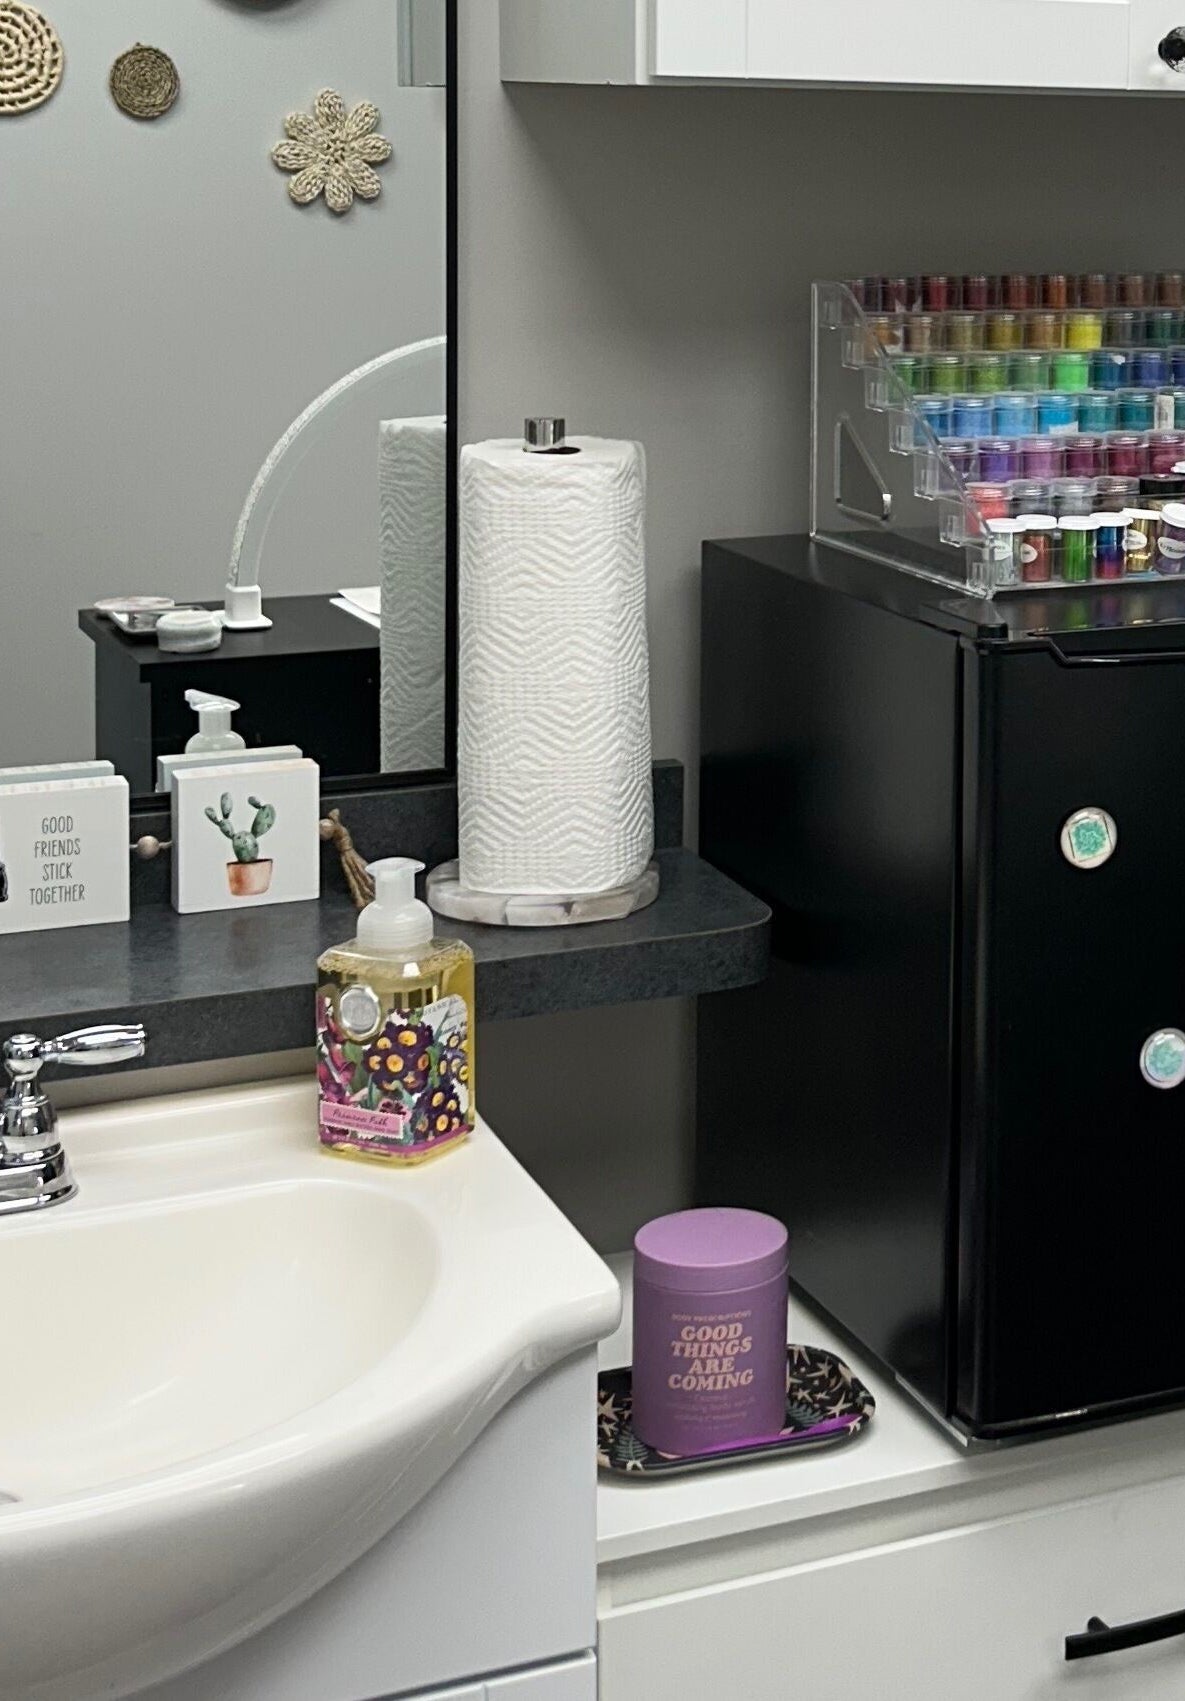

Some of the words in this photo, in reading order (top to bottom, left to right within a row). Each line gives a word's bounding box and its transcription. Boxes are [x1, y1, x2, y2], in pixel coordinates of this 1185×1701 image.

[41, 815, 73, 834] GOOD
[34, 838, 81, 858] FRIENDS
[42, 861, 73, 882] STICK
[29, 883, 86, 906] TOGETHER
[680, 1322, 743, 1341] GOOD
[670, 1335, 753, 1359] THINGS
[688, 1356, 735, 1375] ARE
[667, 1369, 754, 1391] COMING
